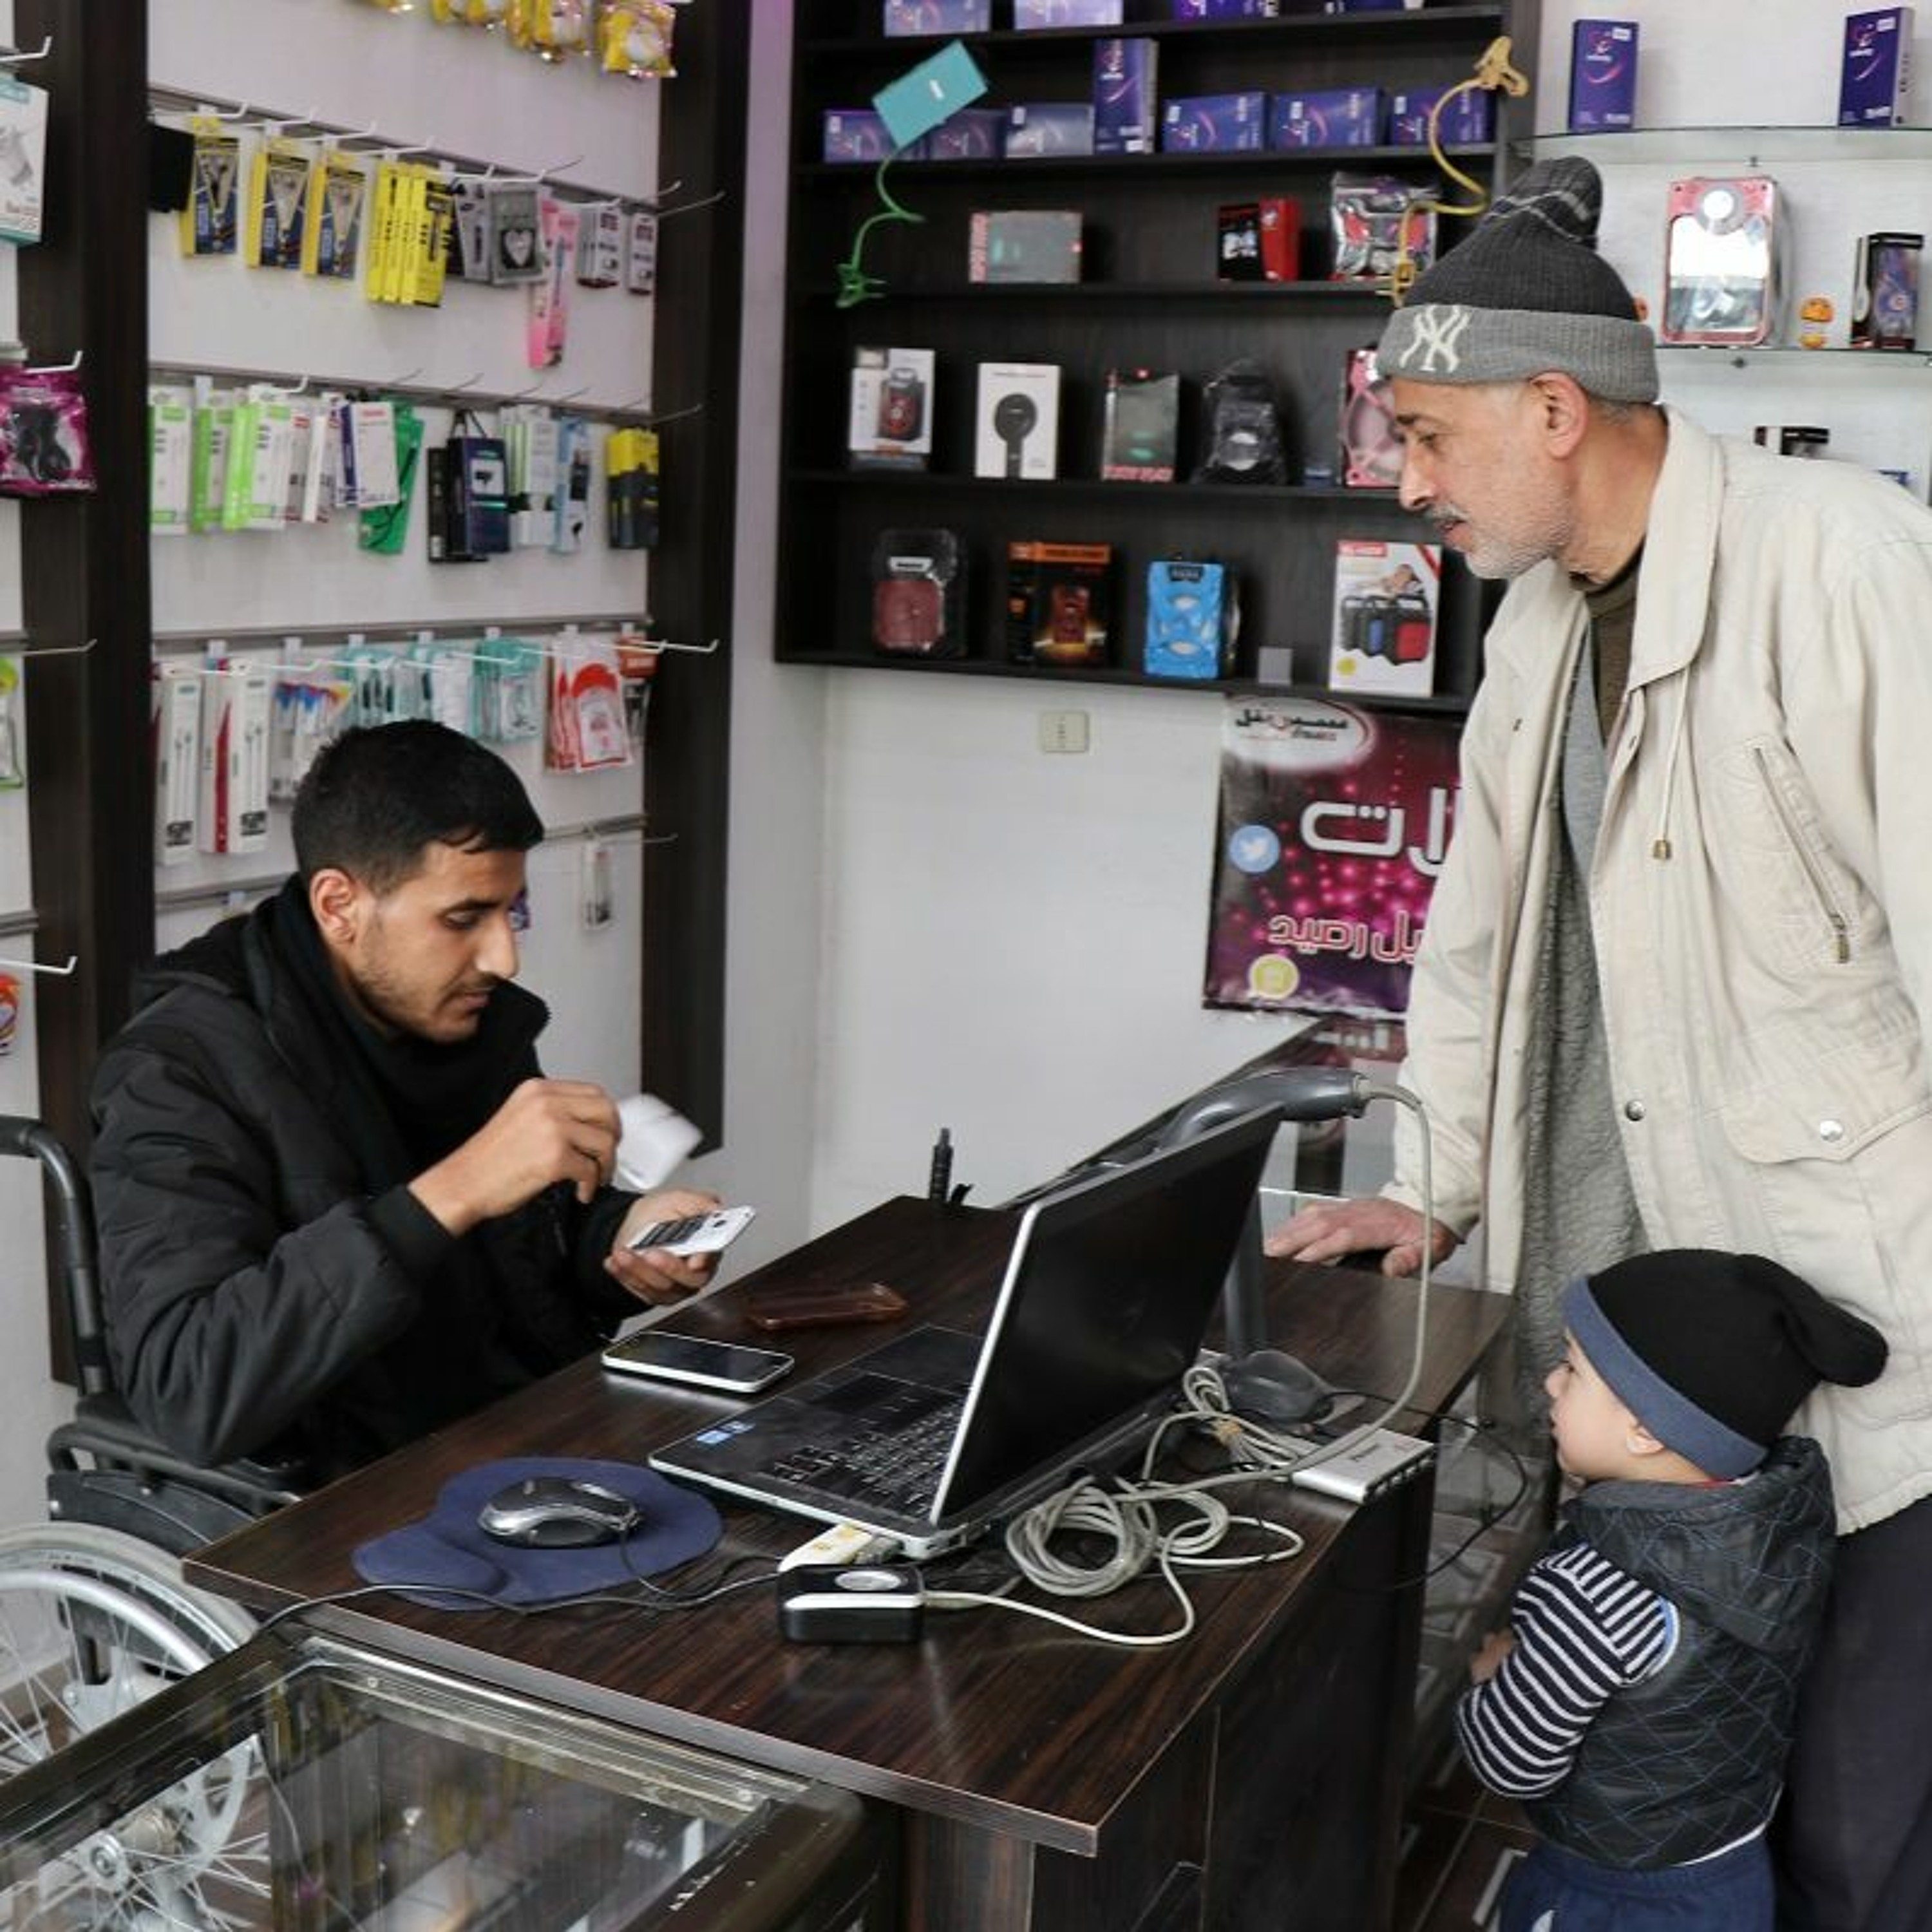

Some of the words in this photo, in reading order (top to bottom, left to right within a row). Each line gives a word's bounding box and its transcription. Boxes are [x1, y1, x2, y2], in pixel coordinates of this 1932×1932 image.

[1399, 305, 1469, 372] NY
[1268, 915, 1368, 959] رصيد
[1370, 910, 1425, 964] يل
